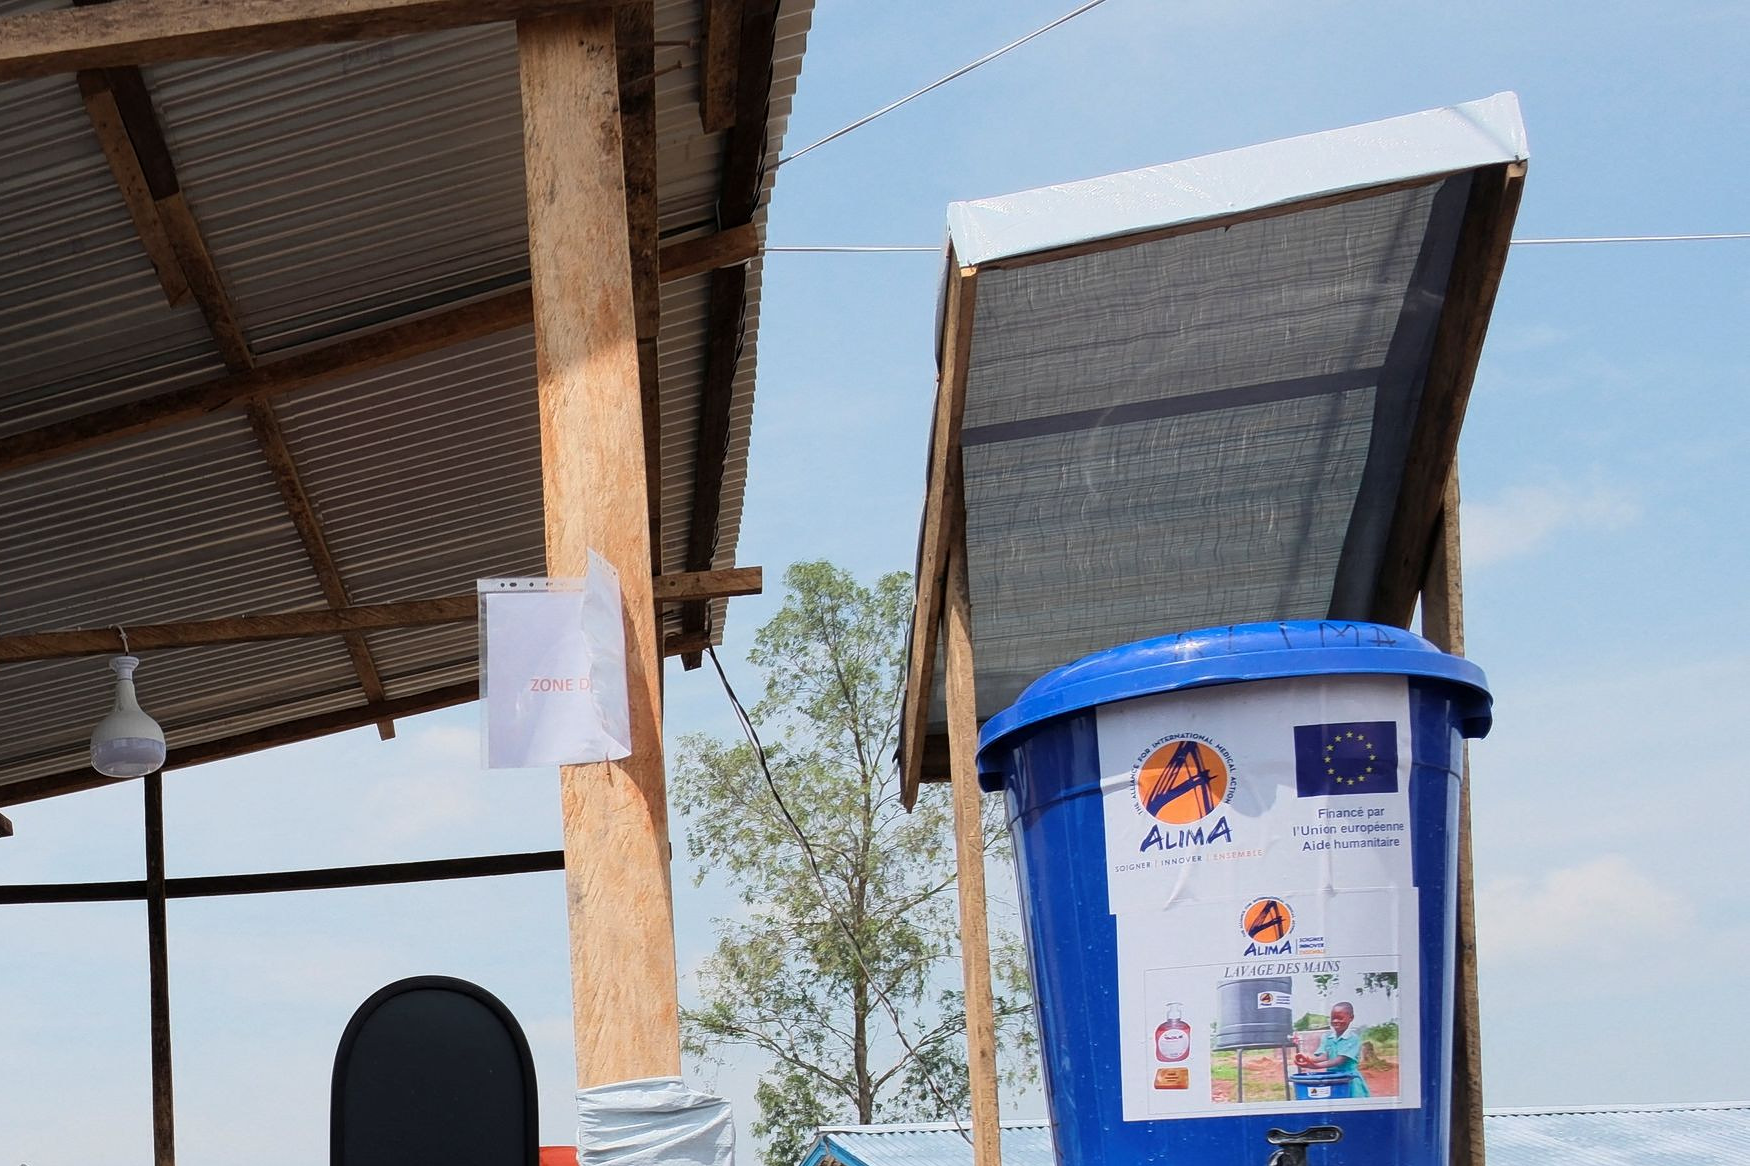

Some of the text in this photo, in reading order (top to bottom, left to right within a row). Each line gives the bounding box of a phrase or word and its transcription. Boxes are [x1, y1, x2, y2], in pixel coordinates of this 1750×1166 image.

[530, 678, 573, 691] ZONE
[1152, 732, 1214, 749] INTERNATIONAL
[1137, 748, 1151, 762] FOR
[1215, 743, 1236, 772] MEDICAL
[1129, 764, 1139, 799] ALLIANCE
[1225, 777, 1237, 805] ACTION
[1318, 807, 1385, 819] Financé par
[1140, 816, 1232, 852] ALIMA
[1293, 821, 1404, 836] l'Union européenne
[1302, 837, 1400, 851] Aide humanitaire
[1115, 849, 1263, 873] SOIGNER INNOVER ENSEMBLE
[1243, 940, 1292, 956] ALIMA
[1224, 960, 1341, 978] LAVAGE DES MAINS
